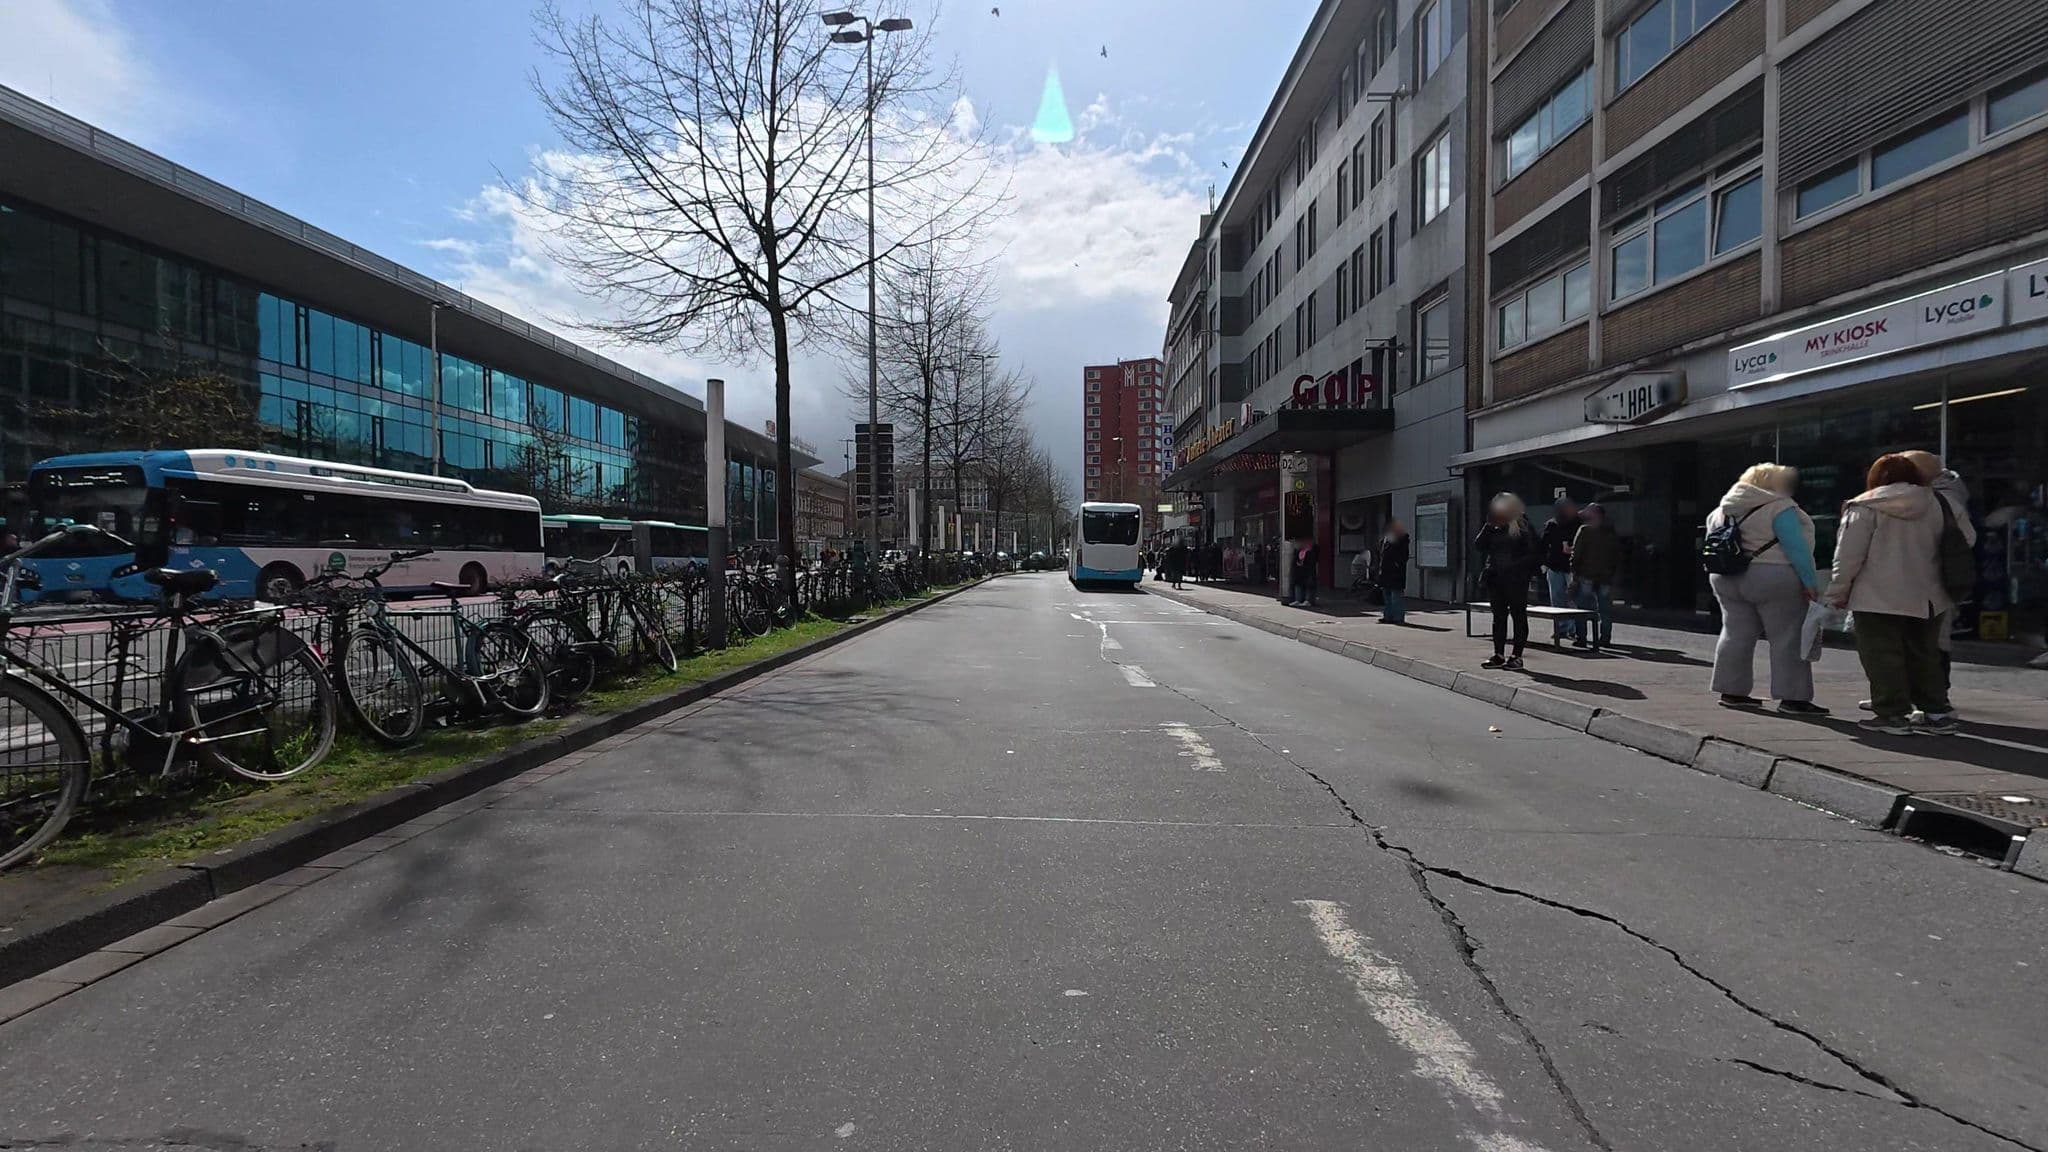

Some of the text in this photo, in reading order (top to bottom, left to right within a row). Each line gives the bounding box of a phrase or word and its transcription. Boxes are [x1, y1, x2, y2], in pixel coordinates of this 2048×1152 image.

[1925, 297, 1976, 323] Lyca
[1805, 318, 1888, 353] MY KIOSK
[1735, 353, 1767, 374] Lyca
[1292, 374, 1378, 406] GOP
[1282, 458, 1293, 470] D2
